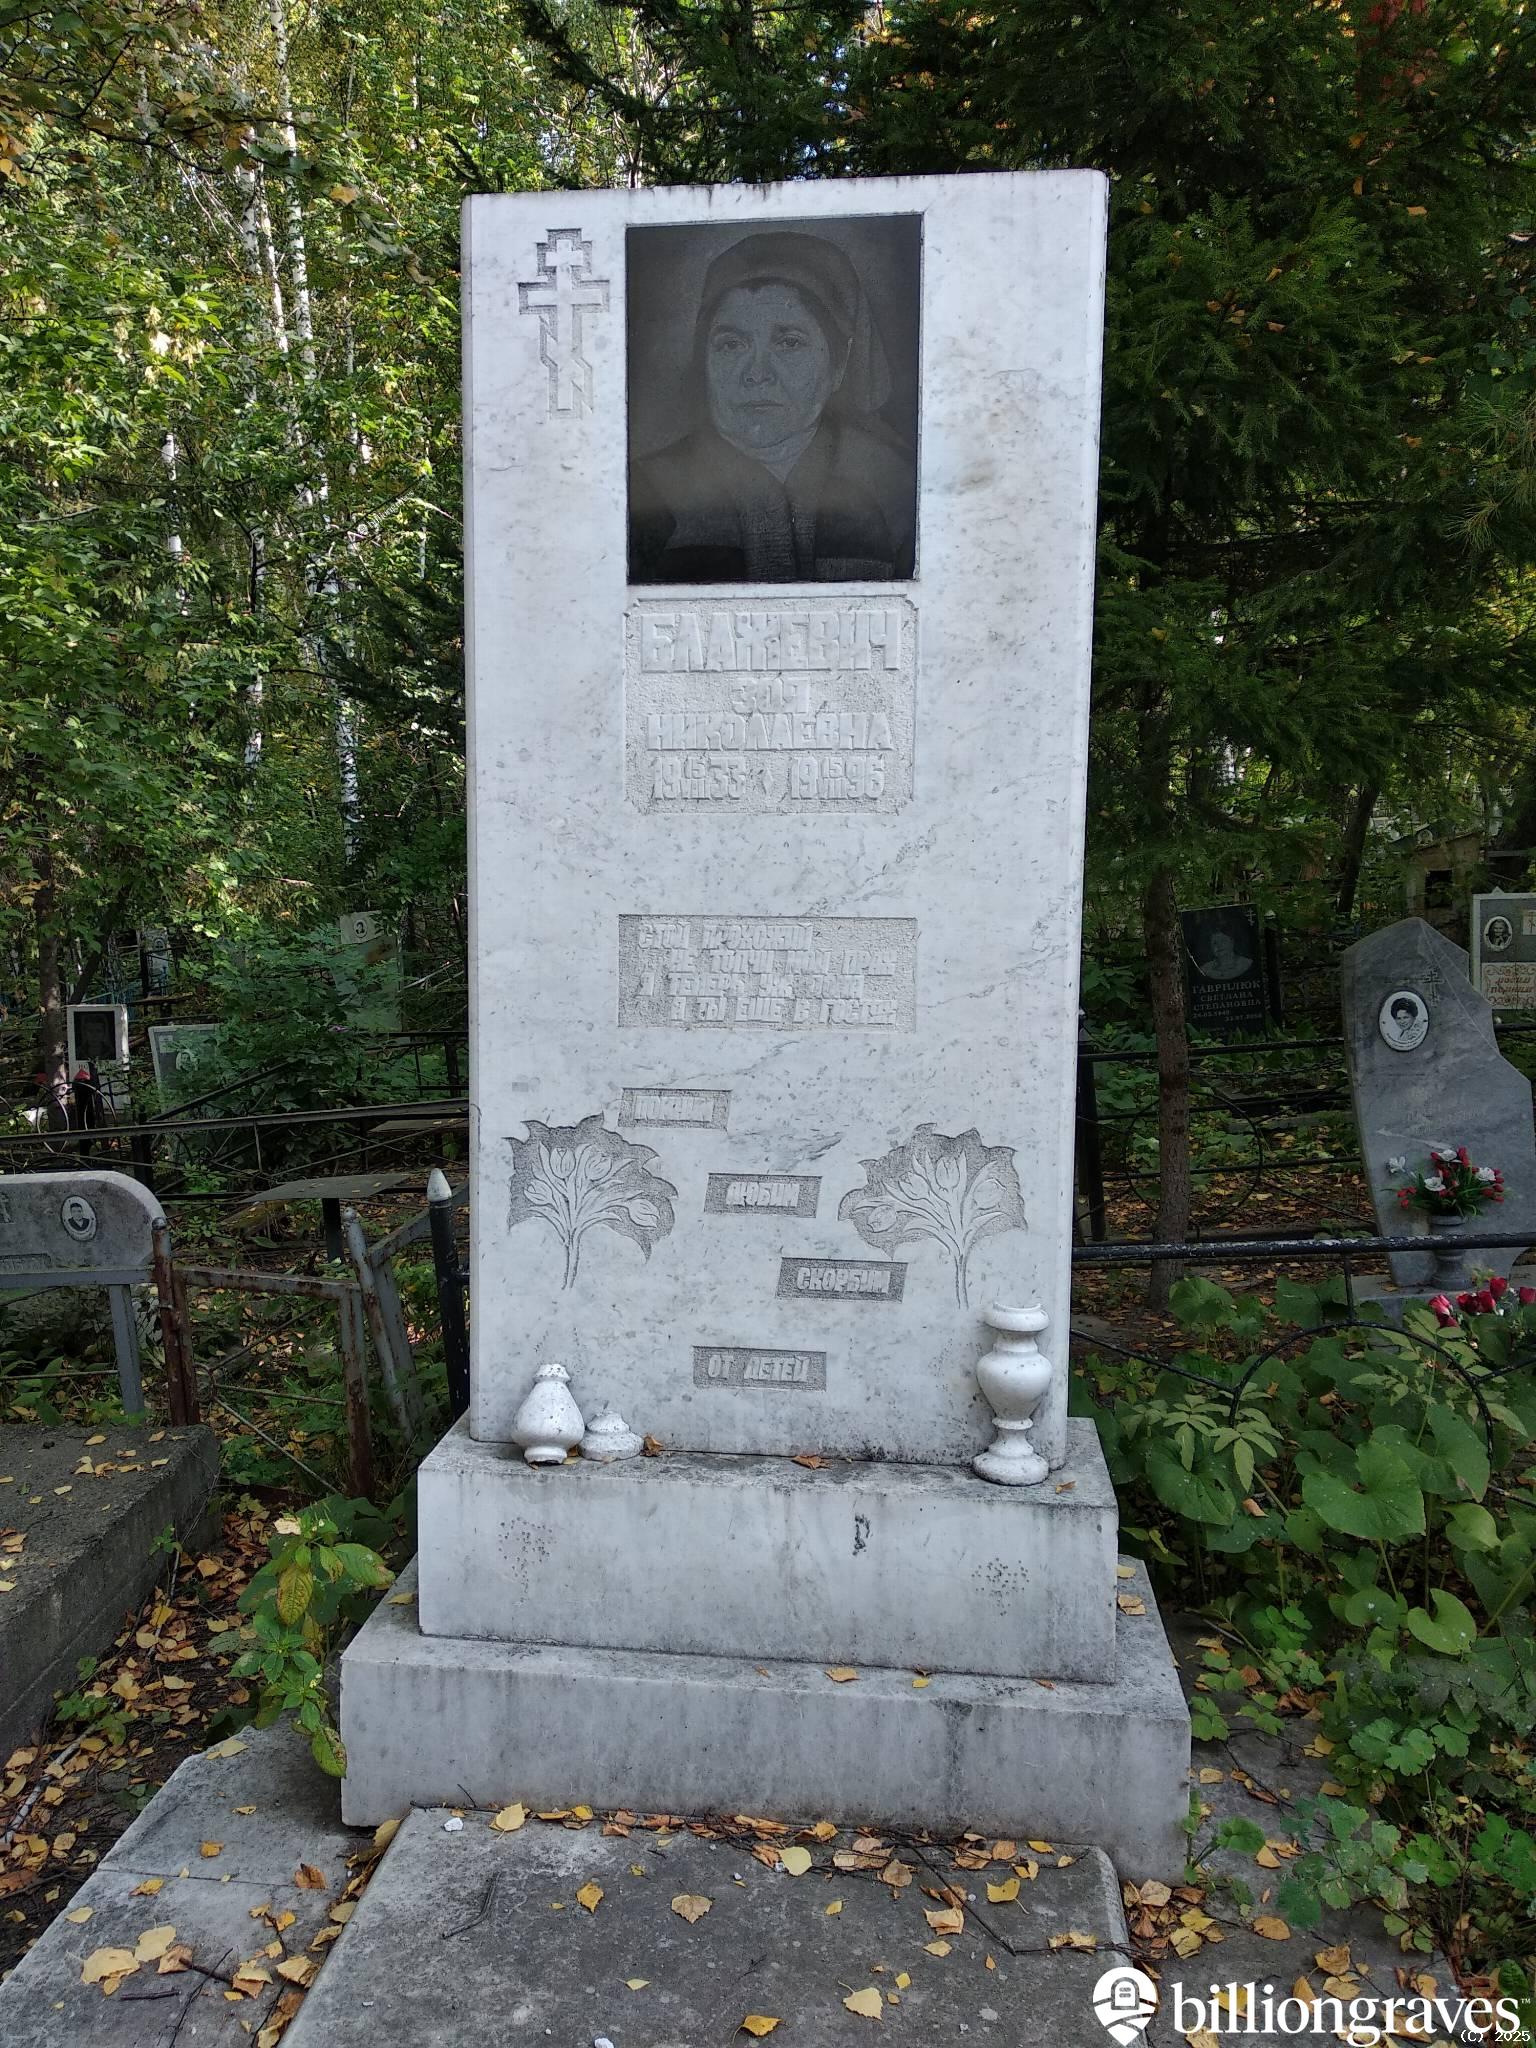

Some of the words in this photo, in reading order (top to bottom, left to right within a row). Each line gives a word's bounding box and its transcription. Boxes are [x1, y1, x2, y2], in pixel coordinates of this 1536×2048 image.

[640, 610, 900, 672] БЛАЖЕВИЧ
[731, 677, 810, 714] ЗОЯ
[647, 712, 894, 751] НИКОЛАЕВНА
[725, 1181, 801, 1208] ЛЮБИМ
[796, 1266, 892, 1295] СКОРБИМ
[707, 1354, 734, 1380] ОТ
[743, 1353, 813, 1383] ДЕТЕЙ
